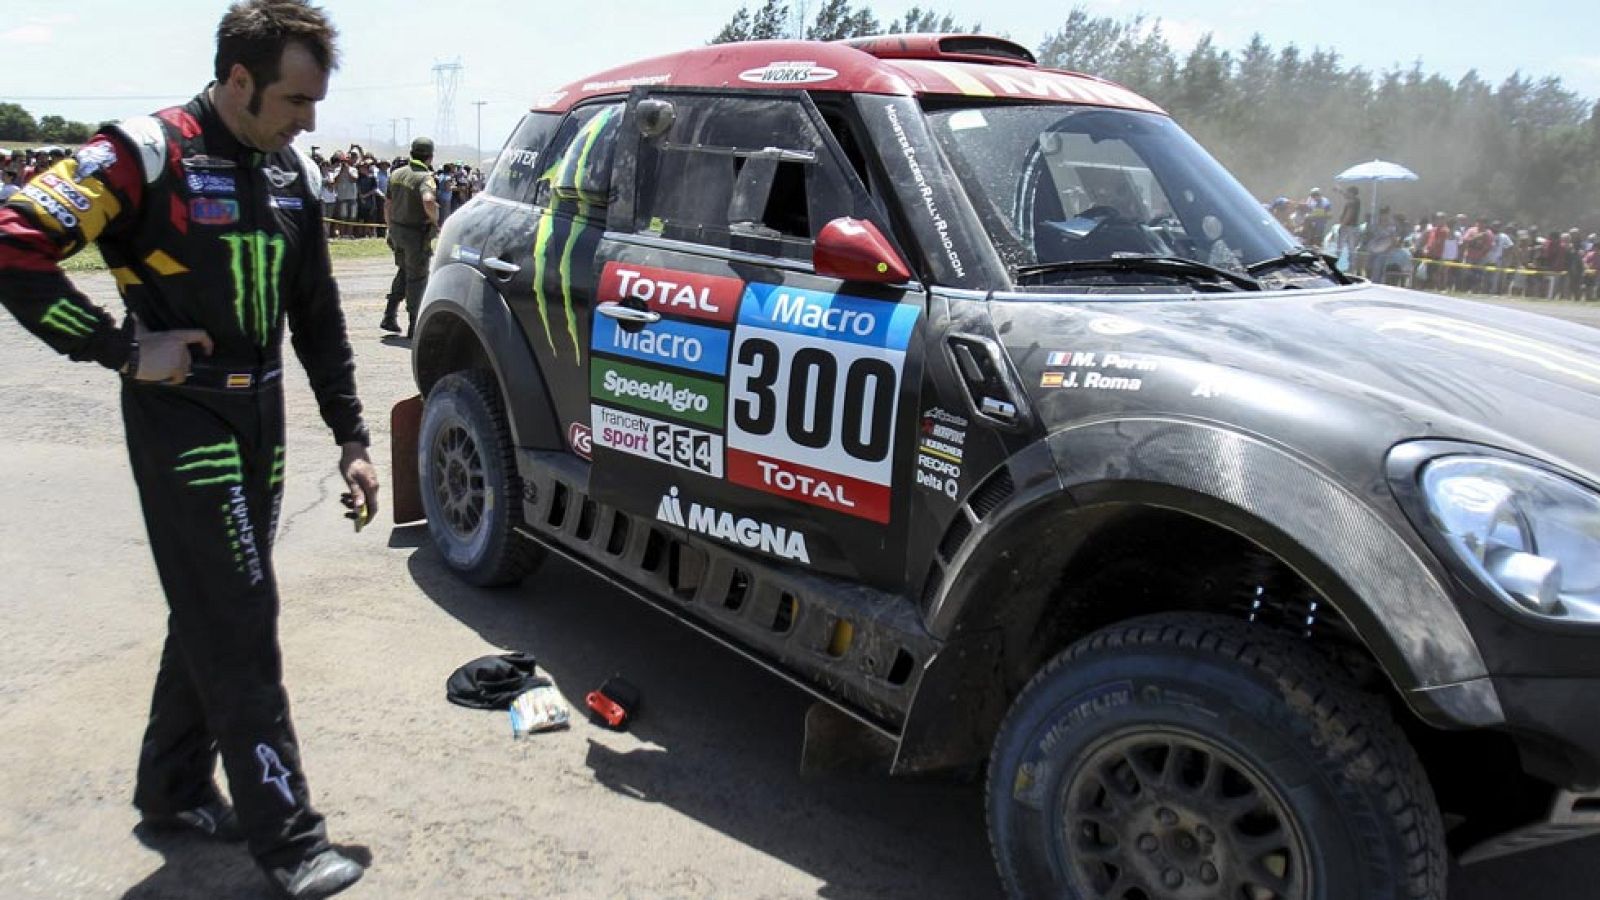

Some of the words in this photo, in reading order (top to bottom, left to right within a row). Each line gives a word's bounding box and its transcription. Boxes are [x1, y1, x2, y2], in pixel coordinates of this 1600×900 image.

[761, 69, 810, 80] WORKS
[616, 269, 719, 312] TOTAL
[771, 293, 875, 336] Macro
[613, 321, 702, 362] Macro
[1071, 352, 1097, 367] M.
[603, 370, 708, 413] SpeedAgro
[734, 338, 897, 463] 300
[1063, 372, 1079, 388] J.
[1084, 372, 1142, 391] Roma
[602, 408, 650, 432] francetv
[603, 427, 649, 453] sport
[758, 460, 855, 507] TOTAL
[917, 469, 942, 491] Delta
[945, 478, 958, 501] Q
[919, 454, 960, 478] RECARO
[689, 503, 810, 563] MAGNA
[1039, 690, 1129, 753] MICHELIN
